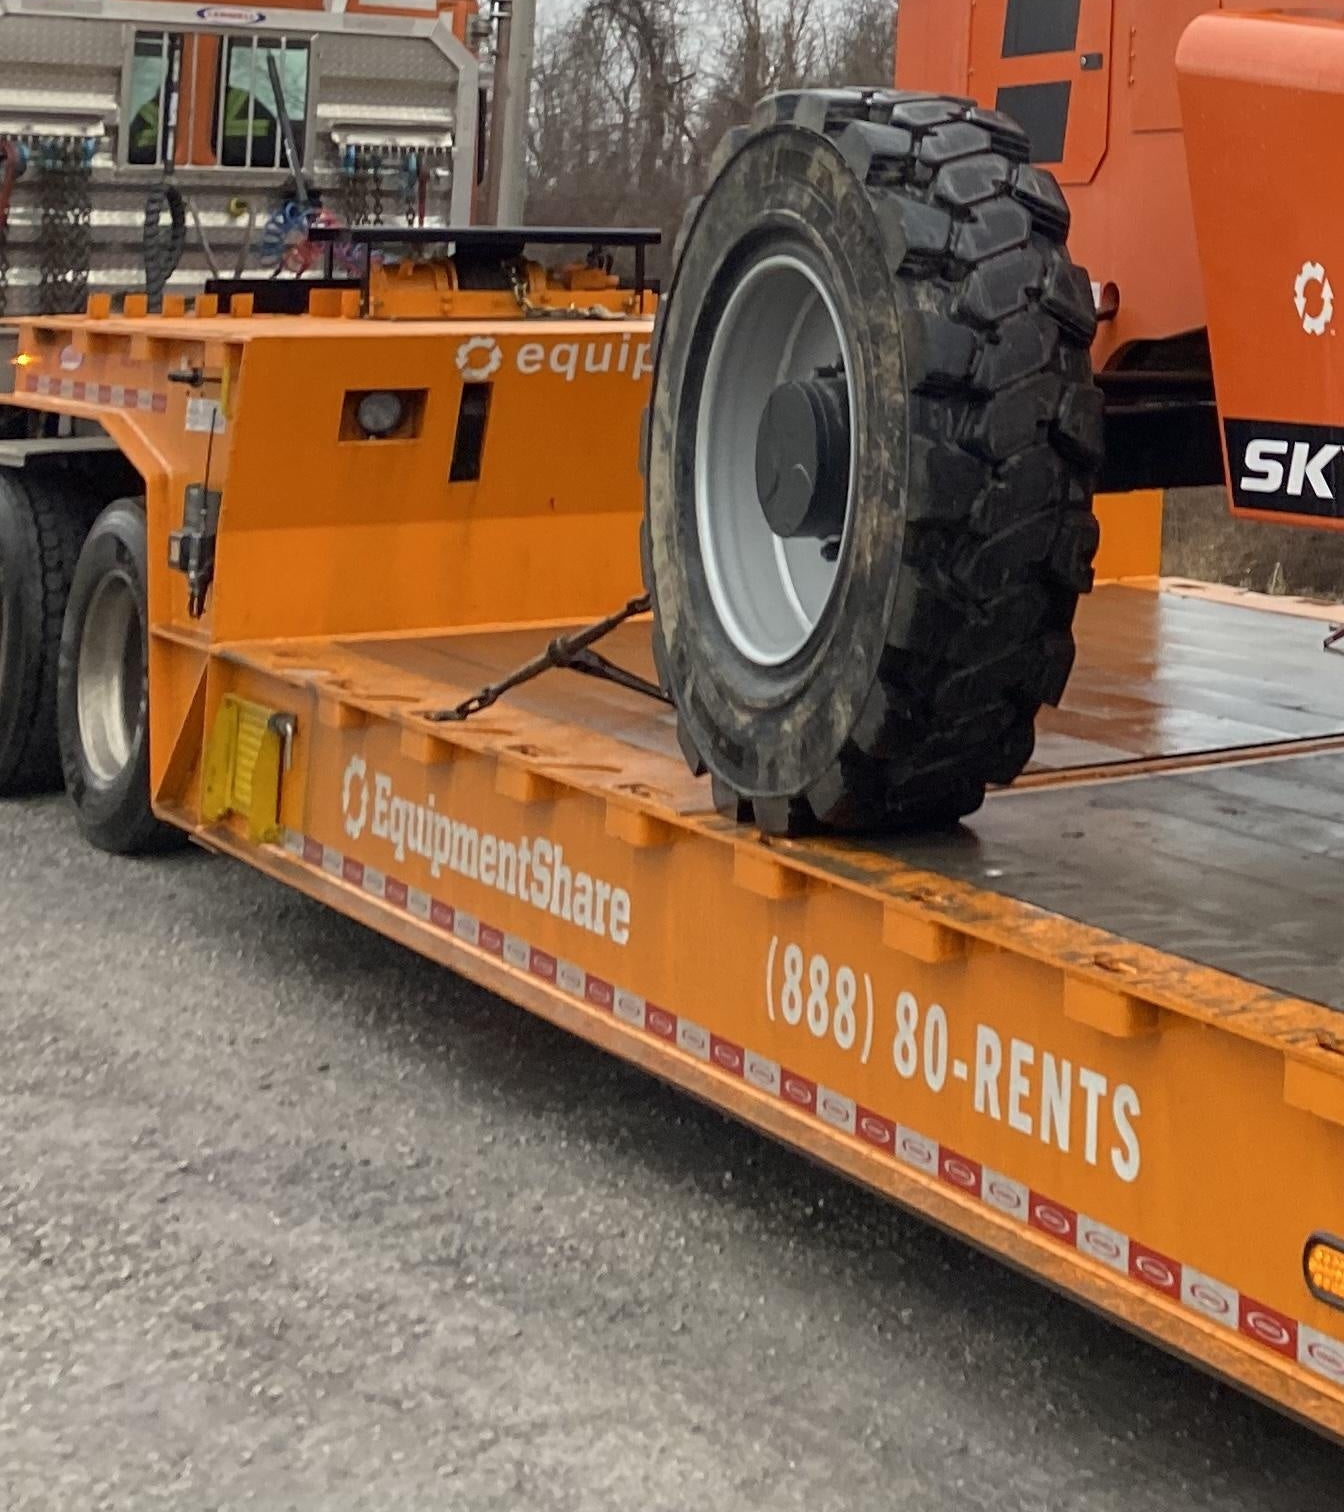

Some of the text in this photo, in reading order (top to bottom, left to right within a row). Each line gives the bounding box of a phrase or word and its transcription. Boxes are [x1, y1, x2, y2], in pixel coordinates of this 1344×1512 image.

[371, 772, 632, 946] EquipmentShare
[766, 935, 1142, 1183] (888) 80-RENTS
